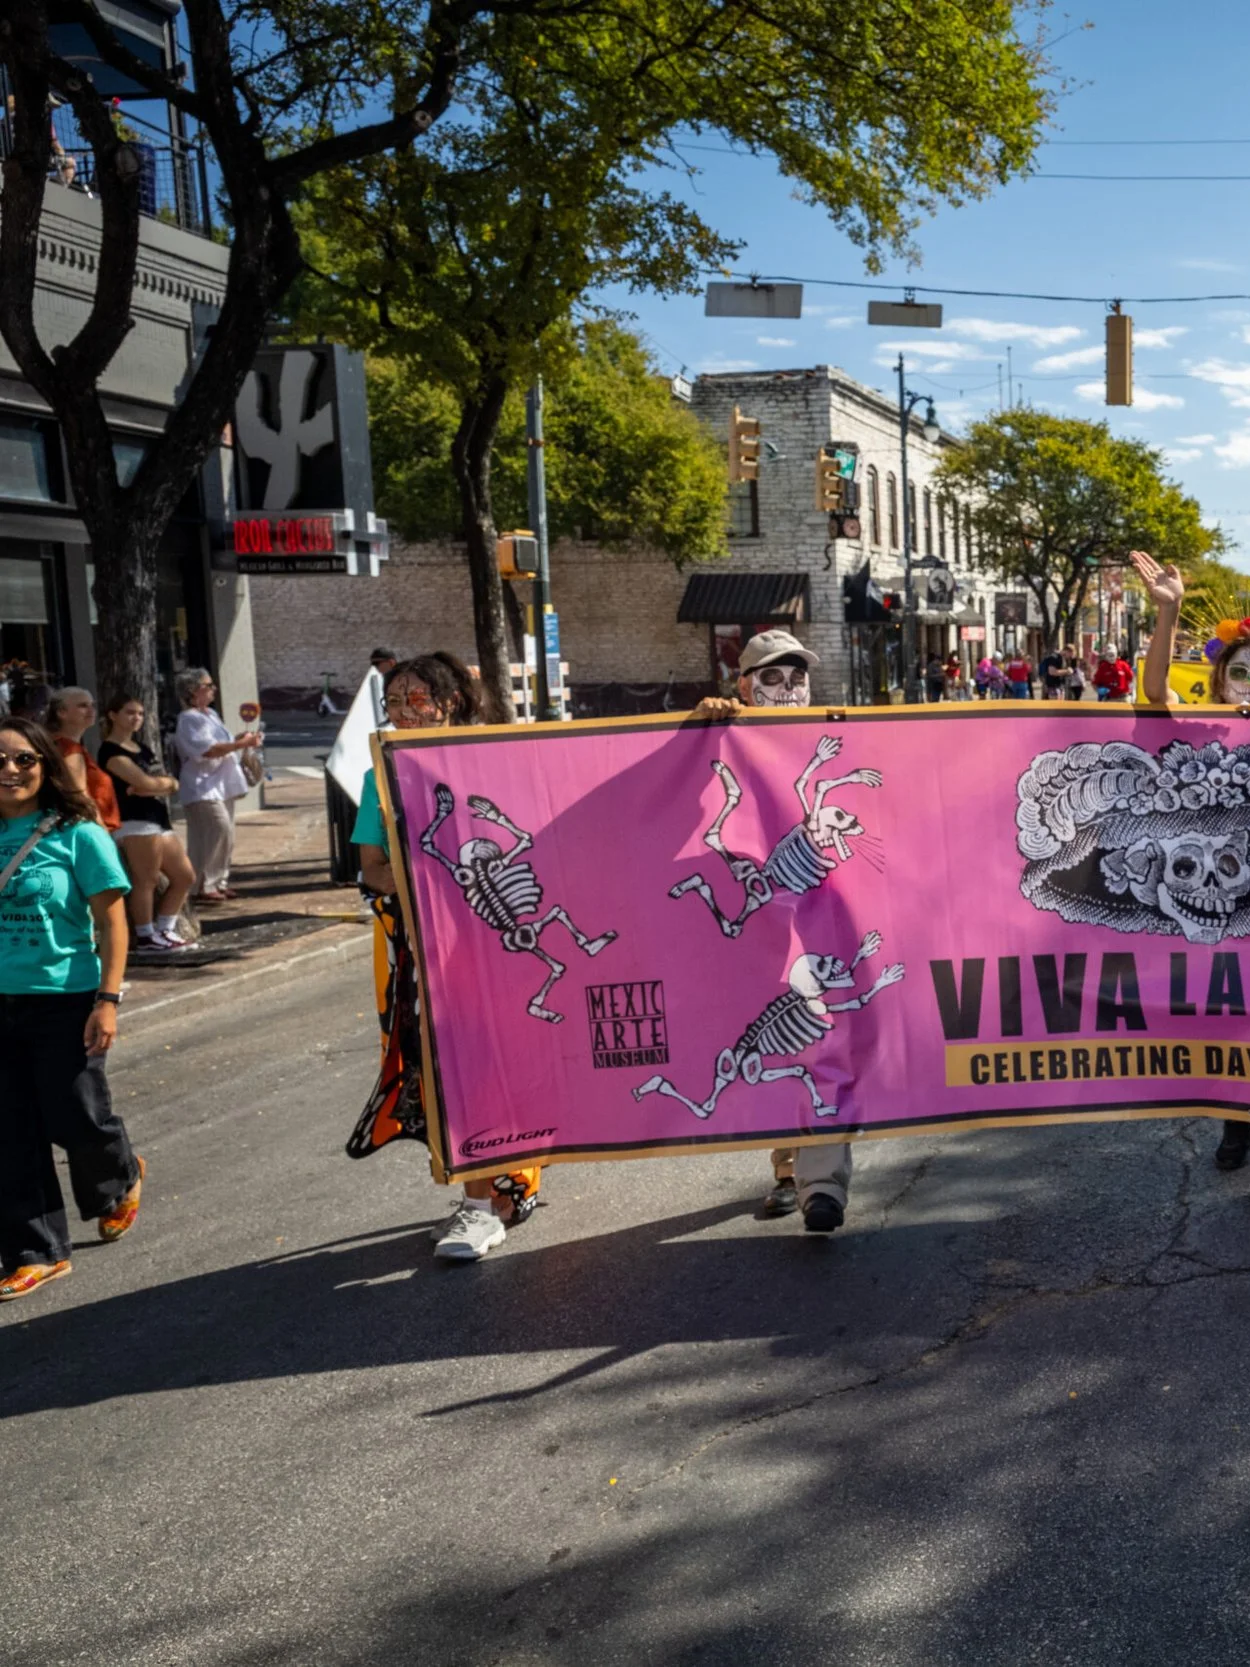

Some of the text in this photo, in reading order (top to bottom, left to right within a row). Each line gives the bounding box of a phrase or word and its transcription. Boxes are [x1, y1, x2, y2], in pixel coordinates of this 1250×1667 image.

[1191, 682, 1205, 697] 4
[589, 983, 662, 1018] MEXIC
[929, 952, 1148, 1040] VIVA
[1170, 951, 1247, 1016] LA
[594, 1017, 665, 1051] ARTE
[594, 1048, 668, 1069] MUSEUM
[970, 1045, 1192, 1085] CELEBRATING
[465, 1127, 558, 1153] BUD LIGHT
